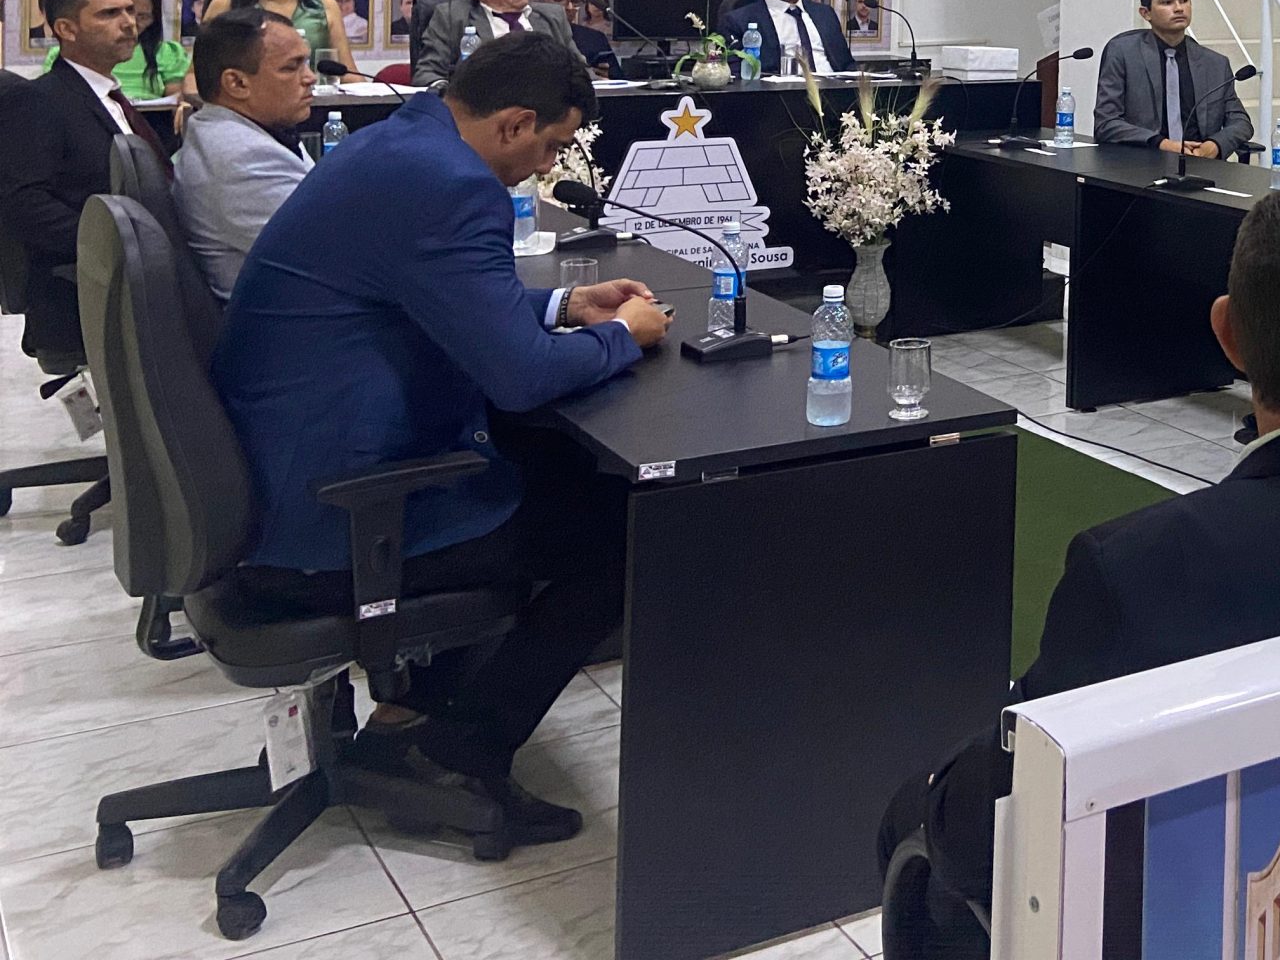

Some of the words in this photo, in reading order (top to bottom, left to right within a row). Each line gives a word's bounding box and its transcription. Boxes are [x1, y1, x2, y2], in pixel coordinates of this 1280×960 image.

[634, 219, 643, 231] 12
[645, 219, 656, 230] DE
[704, 216, 714, 225] DE
[690, 247, 701, 255] DE
[751, 252, 788, 264] Sousa
